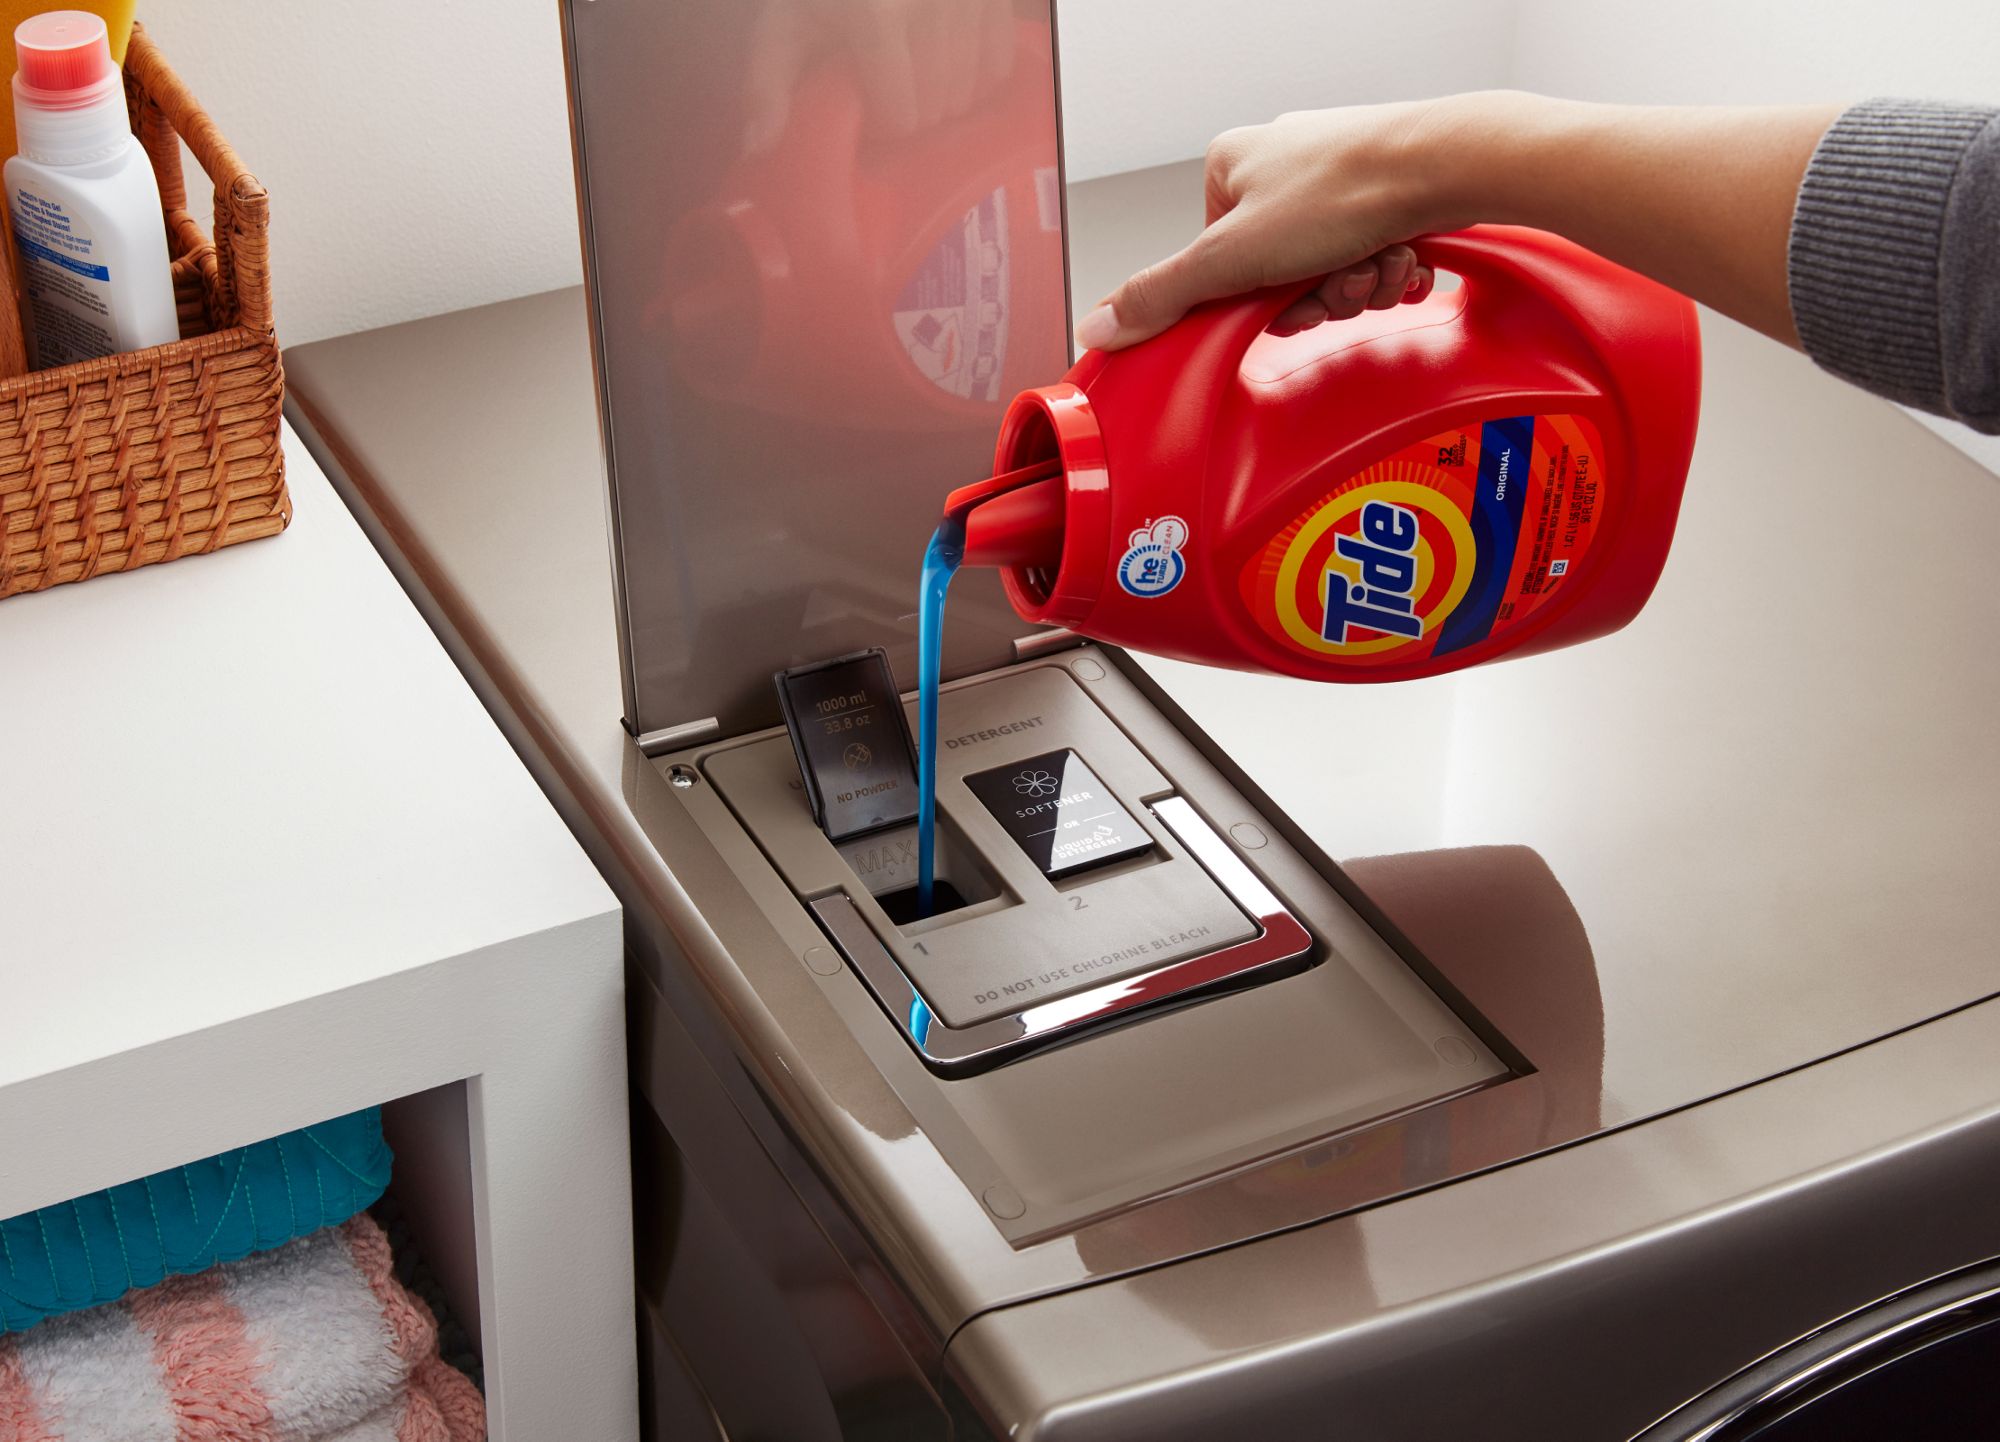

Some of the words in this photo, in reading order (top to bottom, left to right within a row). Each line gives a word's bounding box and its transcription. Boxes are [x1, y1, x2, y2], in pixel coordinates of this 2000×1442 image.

[1438, 448, 1454, 467] 32
[1496, 448, 1510, 501] ORIGINAL
[1162, 525, 1173, 555] CLEAN
[1135, 557, 1159, 583] he
[1156, 559, 1168, 584] TURBO
[1321, 500, 1424, 646] Tide
[815, 695, 848, 714] 1000
[850, 690, 867, 705] ml
[824, 717, 853, 735] 33.8
[855, 715, 871, 727] oz
[944, 716, 1044, 750] DETERGENT
[837, 791, 853, 804] NO
[856, 779, 898, 799] POWDER
[1015, 791, 1093, 818] SOFTENER
[1063, 820, 1081, 829] OR
[1053, 835, 1093, 853] LIQUID
[1058, 836, 1122, 859] DETERGENT
[855, 839, 914, 875] MAX
[1067, 895, 1089, 911] 2
[913, 942, 929, 956] 1
[973, 990, 999, 1005] DO
[1002, 978, 1036, 997] NOT
[1039, 968, 1070, 985] USE
[1072, 944, 1149, 974] CHLORINE
[1150, 926, 1212, 951] BLEACH
